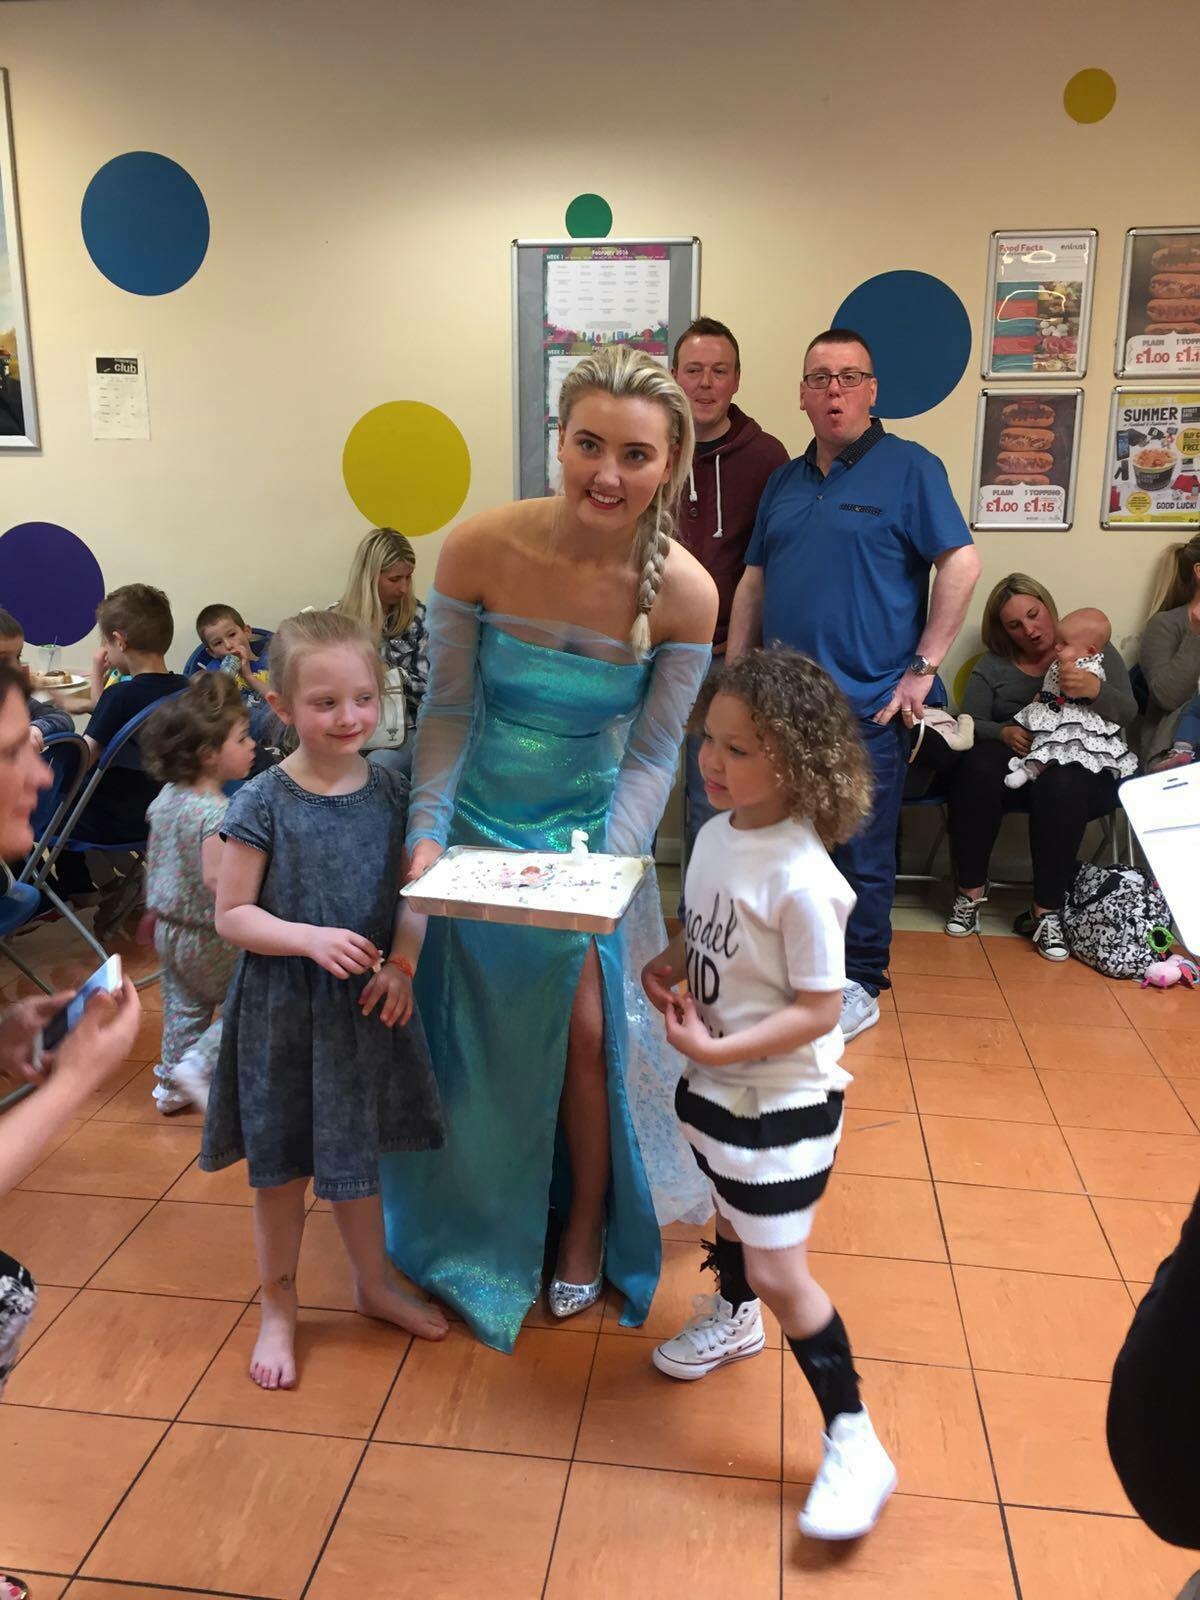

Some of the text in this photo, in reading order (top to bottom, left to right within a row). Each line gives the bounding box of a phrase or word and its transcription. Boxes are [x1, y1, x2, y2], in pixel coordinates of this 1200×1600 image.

[999, 243, 1044, 252] Food Facts
[1135, 347, 1170, 364] £1.00
[1175, 346, 1200, 362] £1.1
[114, 362, 137, 374] club
[1123, 406, 1178, 422] SUMMER
[985, 496, 1019, 513] £1.00
[1024, 496, 1055, 513] £1.15
[1156, 502, 1175, 510] GOOD
[686, 892, 740, 959] odel
